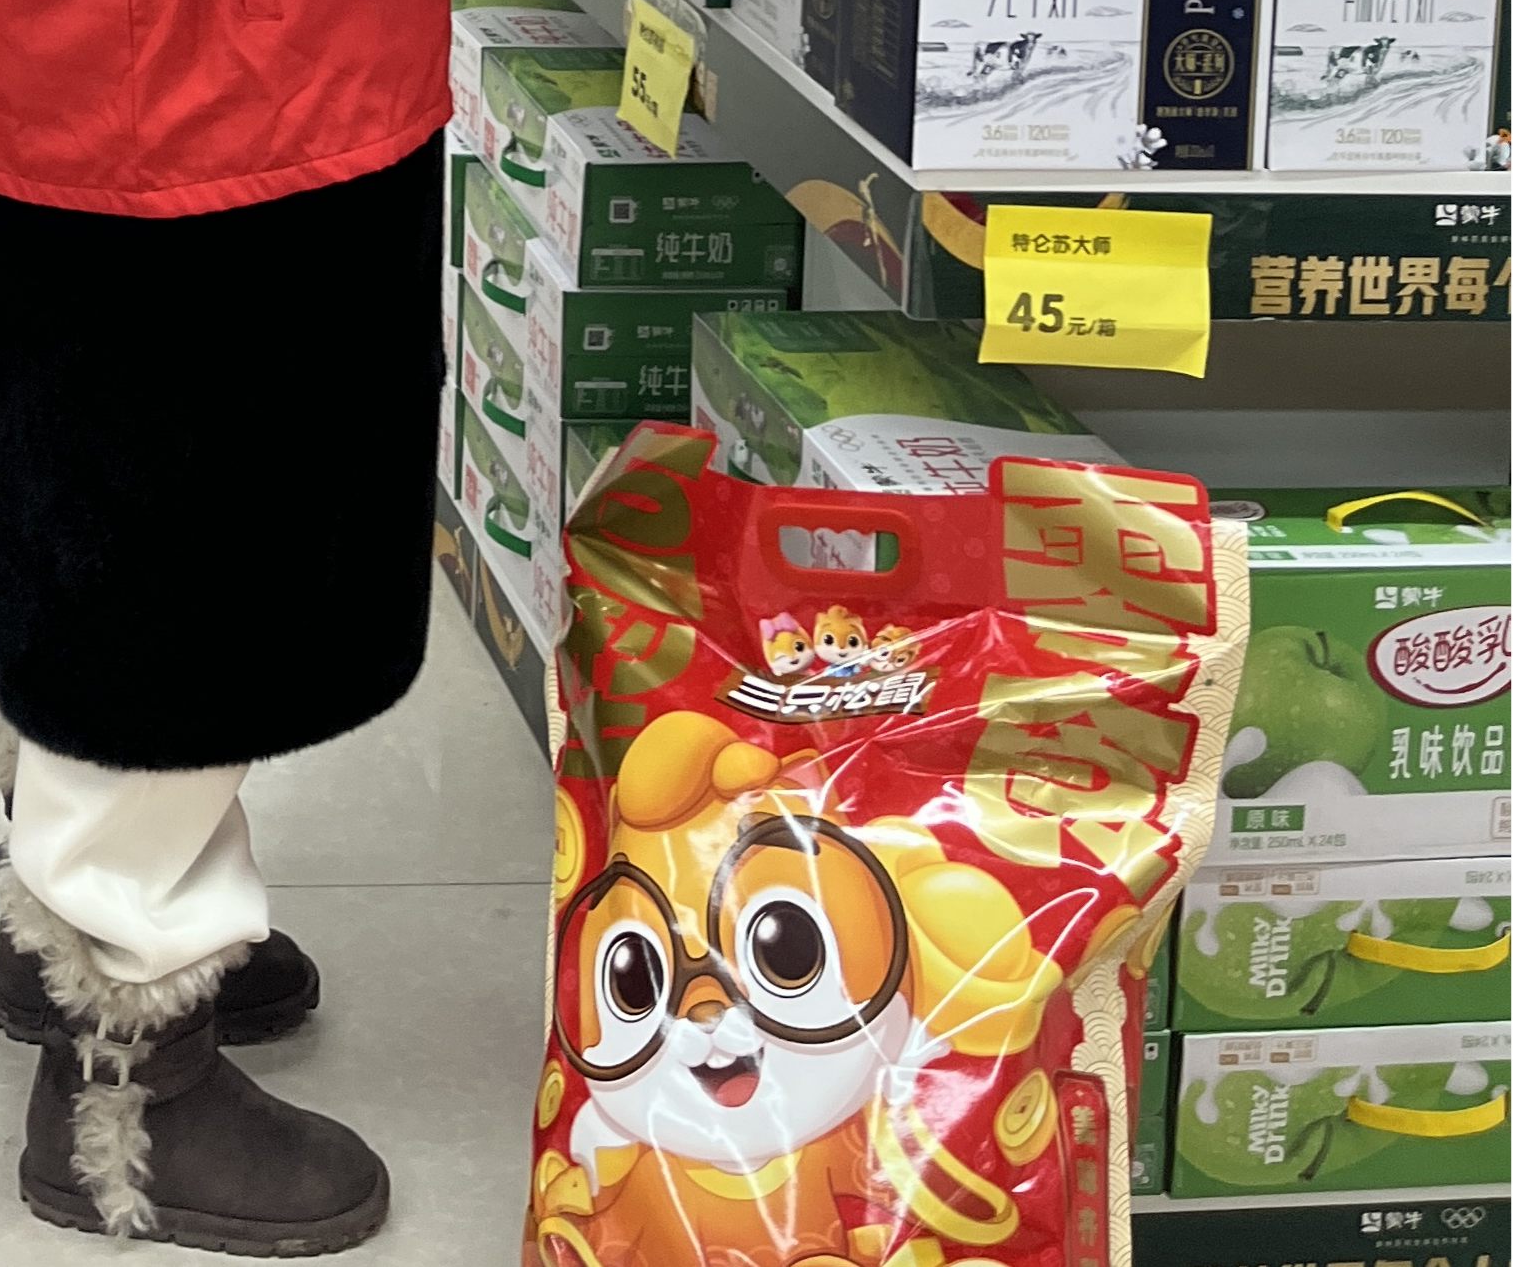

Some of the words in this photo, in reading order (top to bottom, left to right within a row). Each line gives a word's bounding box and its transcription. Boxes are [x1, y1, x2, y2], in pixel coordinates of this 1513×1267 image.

[656, 232, 732, 264] 纯牛奶
[1011, 234, 1111, 256] 特仑苏大师
[1393, 613, 1512, 676] 酸酸乳
[729, 672, 931, 718] 三只松鼠
[1389, 723, 1505, 780] 乳味饮品
[1246, 809, 1290, 829] 原味
[1248, 917, 1271, 987] Milky
[1248, 1084, 1271, 1154] Milky
